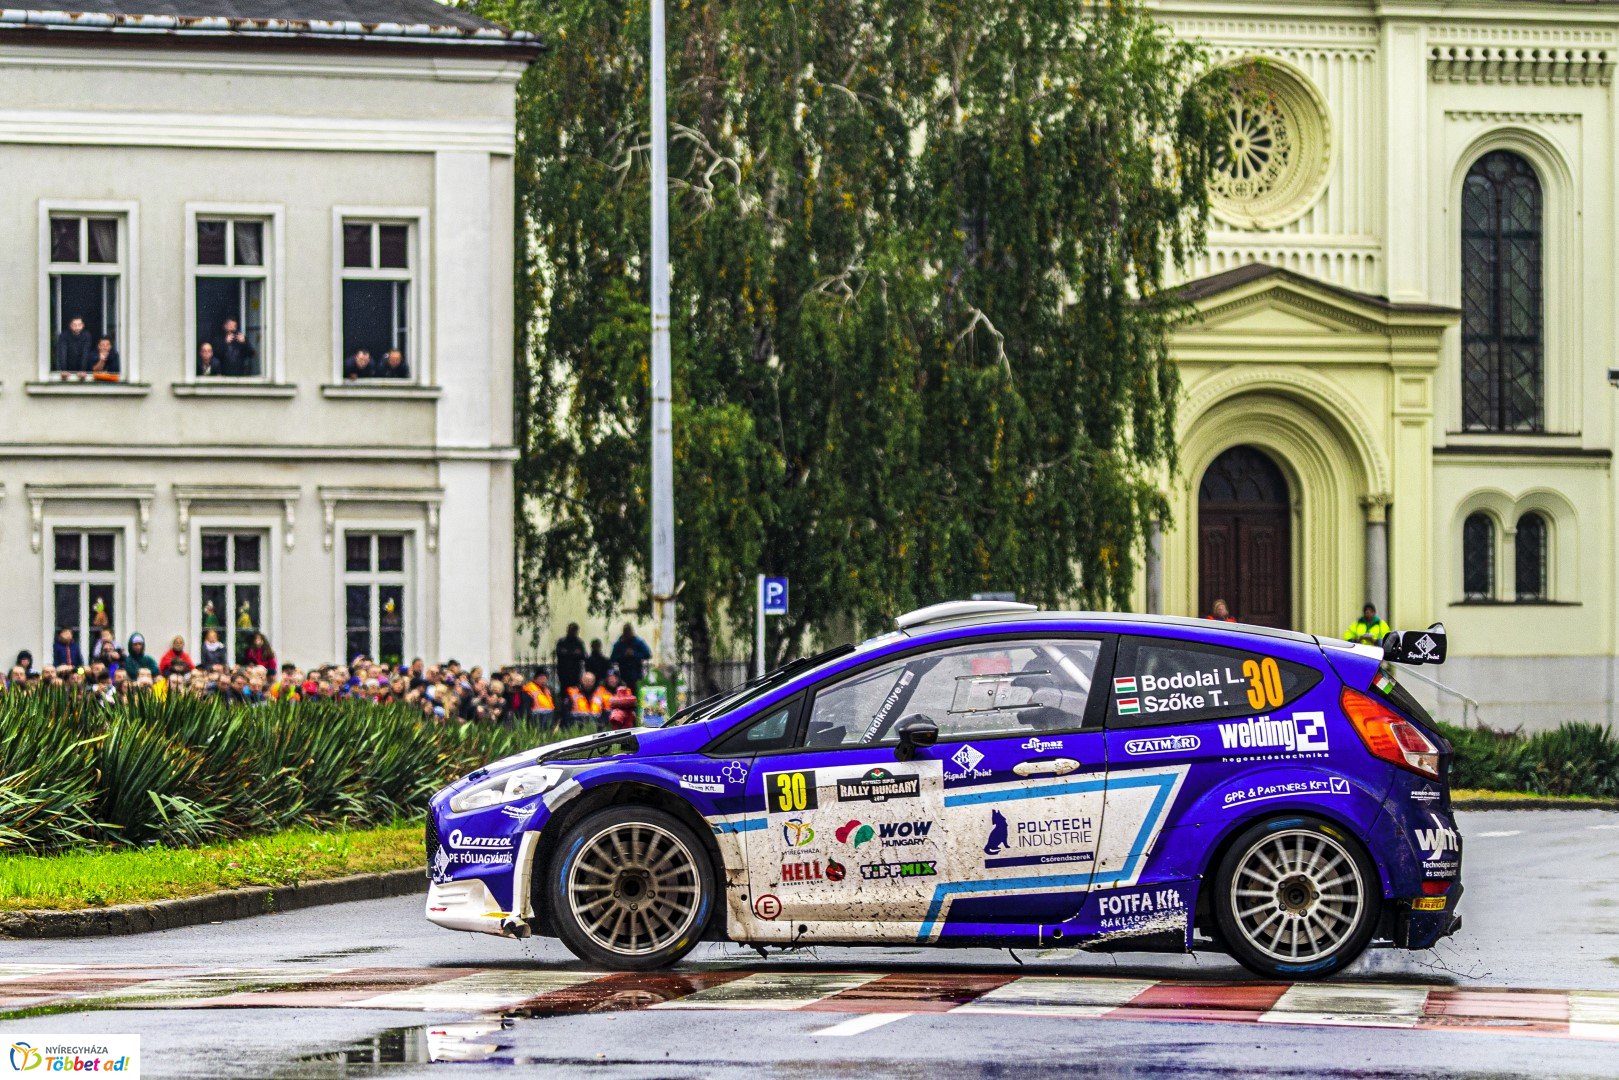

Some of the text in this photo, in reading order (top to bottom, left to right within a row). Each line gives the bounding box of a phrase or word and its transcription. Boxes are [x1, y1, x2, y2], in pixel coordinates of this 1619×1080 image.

[767, 582, 783, 605] P
[1141, 668, 1245, 692] Bodolai L.
[1242, 657, 1284, 710] 30
[1144, 690, 1229, 713] Szőke T.
[1218, 715, 1296, 751] welding
[682, 774, 722, 783] CONSULT
[943, 769, 967, 782] Signal
[973, 768, 993, 779] Point
[777, 772, 807, 812] 30
[839, 780, 918, 798] RALLY HUNGARY
[1224, 780, 1329, 804] GPR & PARTNERS KFT
[879, 821, 932, 838] WOW
[1017, 817, 1092, 834] POLYTECH
[881, 838, 927, 848] HUNGARY
[1018, 830, 1093, 848] INDUSTRIE
[449, 850, 513, 864] PE FÓLIAGYÁRTÁS
[781, 861, 823, 881] HELL
[1099, 889, 1183, 916] FOTFA Kft.
